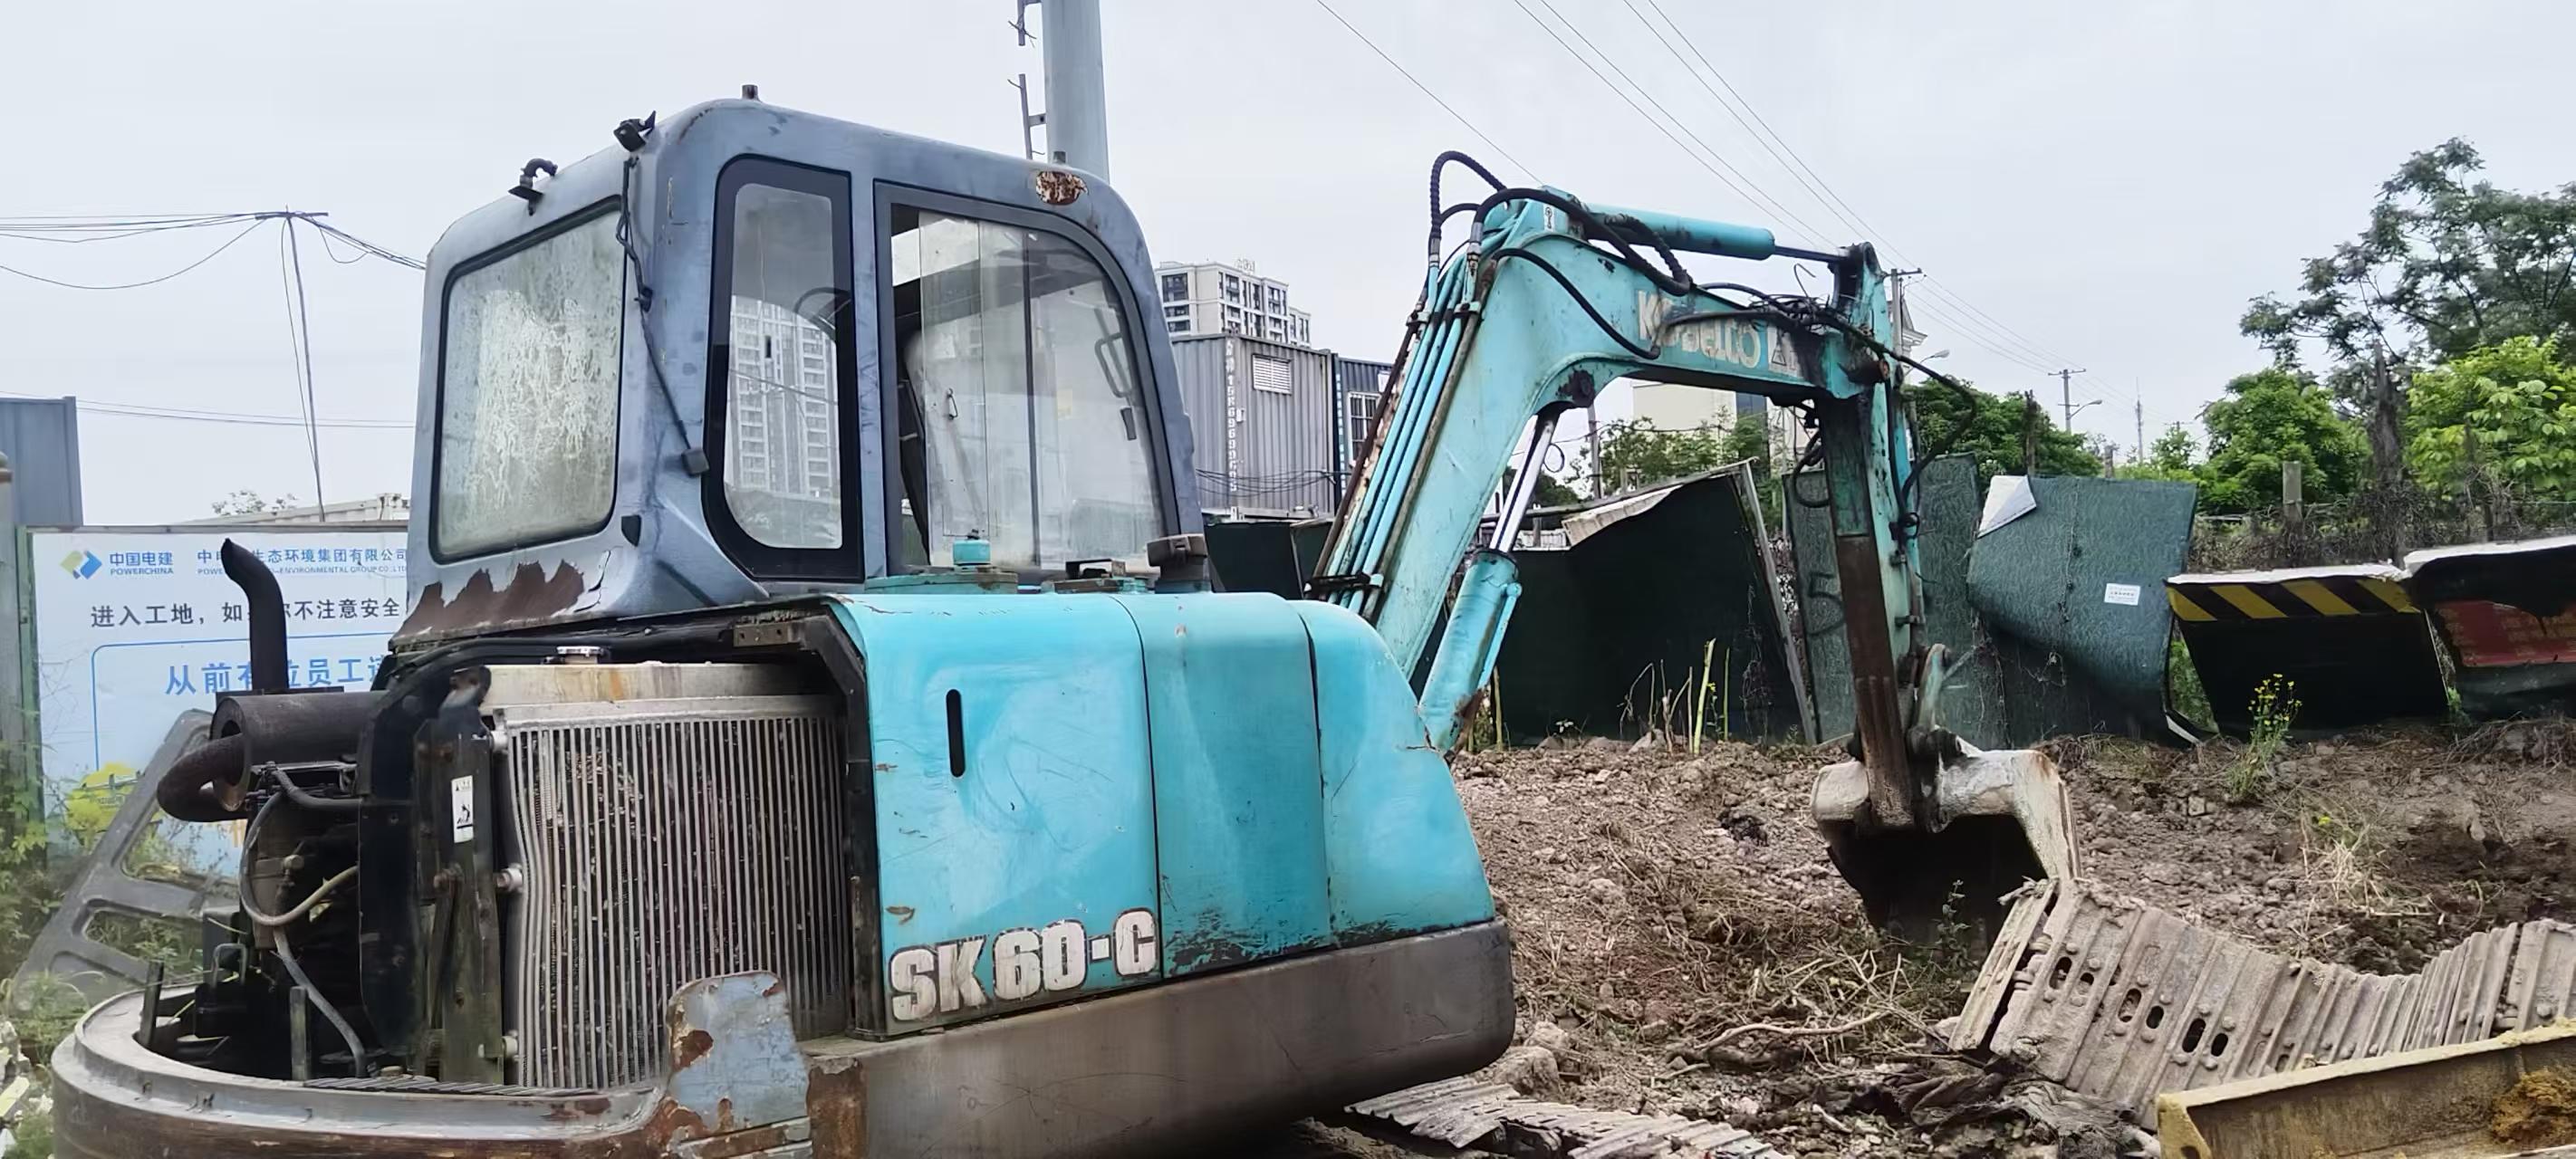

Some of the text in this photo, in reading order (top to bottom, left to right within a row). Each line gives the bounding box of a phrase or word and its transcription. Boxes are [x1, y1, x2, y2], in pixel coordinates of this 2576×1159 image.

[110, 551, 173, 566] 中国电建
[197, 548, 407, 563] 中生态环境集团有限公司
[91, 597, 400, 627] 进入工地，如你不注意安全
